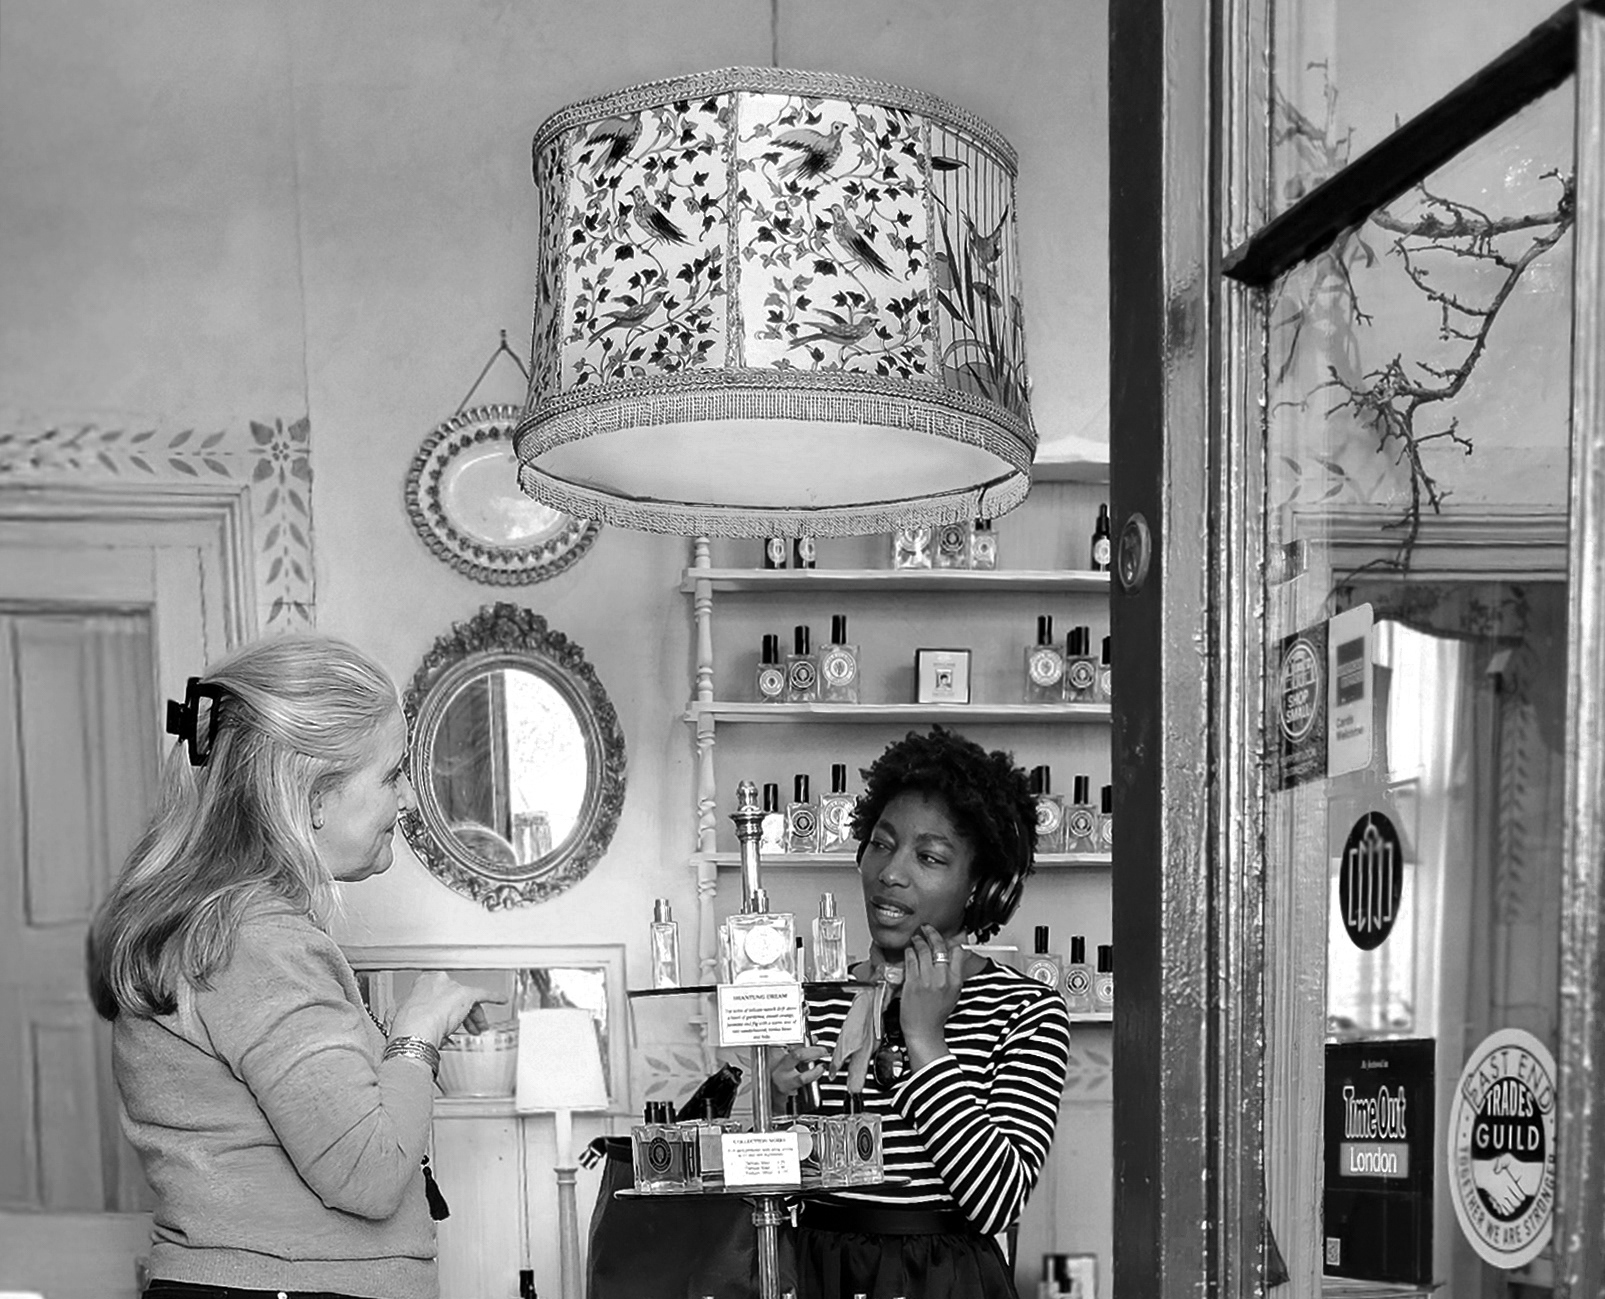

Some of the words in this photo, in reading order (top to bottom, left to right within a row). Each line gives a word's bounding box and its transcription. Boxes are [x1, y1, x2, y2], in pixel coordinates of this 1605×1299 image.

[1287, 688, 1309, 708] SHOP
[1285, 701, 1312, 724] SMALL
[1463, 1050, 1509, 1110] EAST
[1517, 1053, 1554, 1112] END
[1486, 1080, 1535, 1118] TRADES
[1476, 1123, 1541, 1151] GUILD
[1350, 1146, 1398, 1173] London
